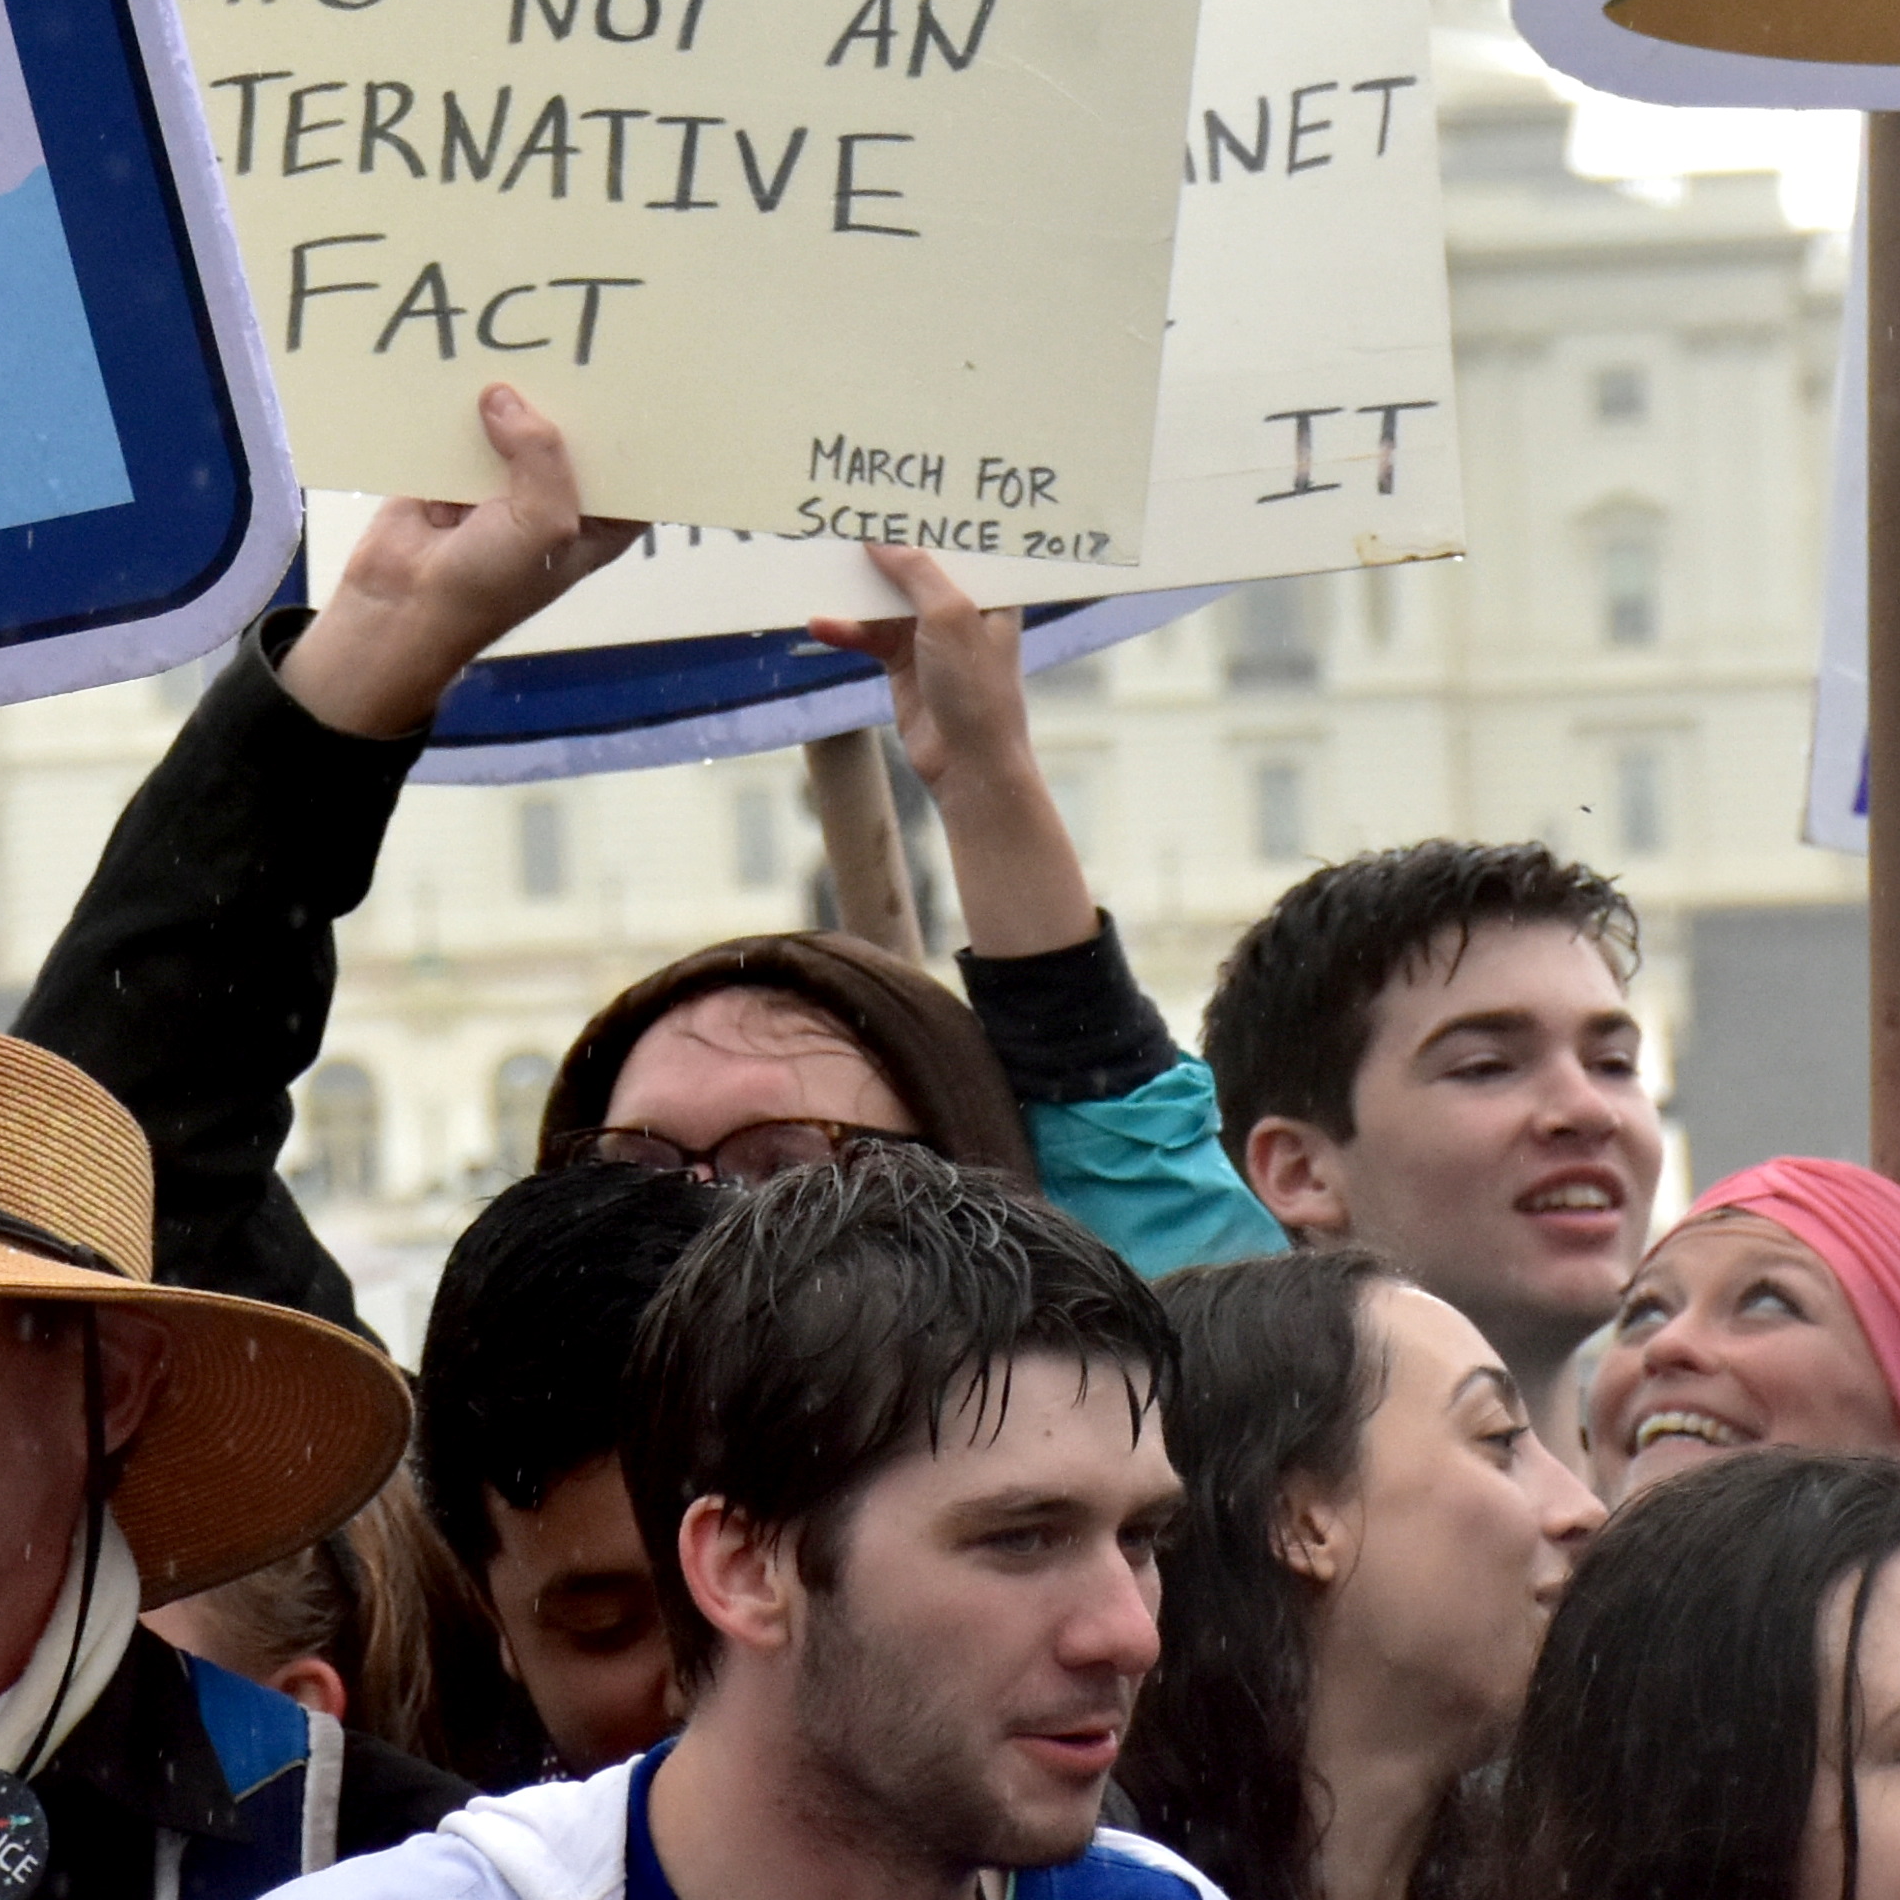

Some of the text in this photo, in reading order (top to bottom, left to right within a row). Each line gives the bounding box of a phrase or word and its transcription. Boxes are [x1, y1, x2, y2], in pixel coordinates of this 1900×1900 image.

[210, 70, 922, 238] TERNATIVE
[1183, 74, 1418, 185] NET
[286, 233, 645, 366] FACT
[809, 433, 1060, 510] MARCH FOR
[1255, 400, 1440, 504] IT
[780, 496, 1001, 551] SCIENCE
